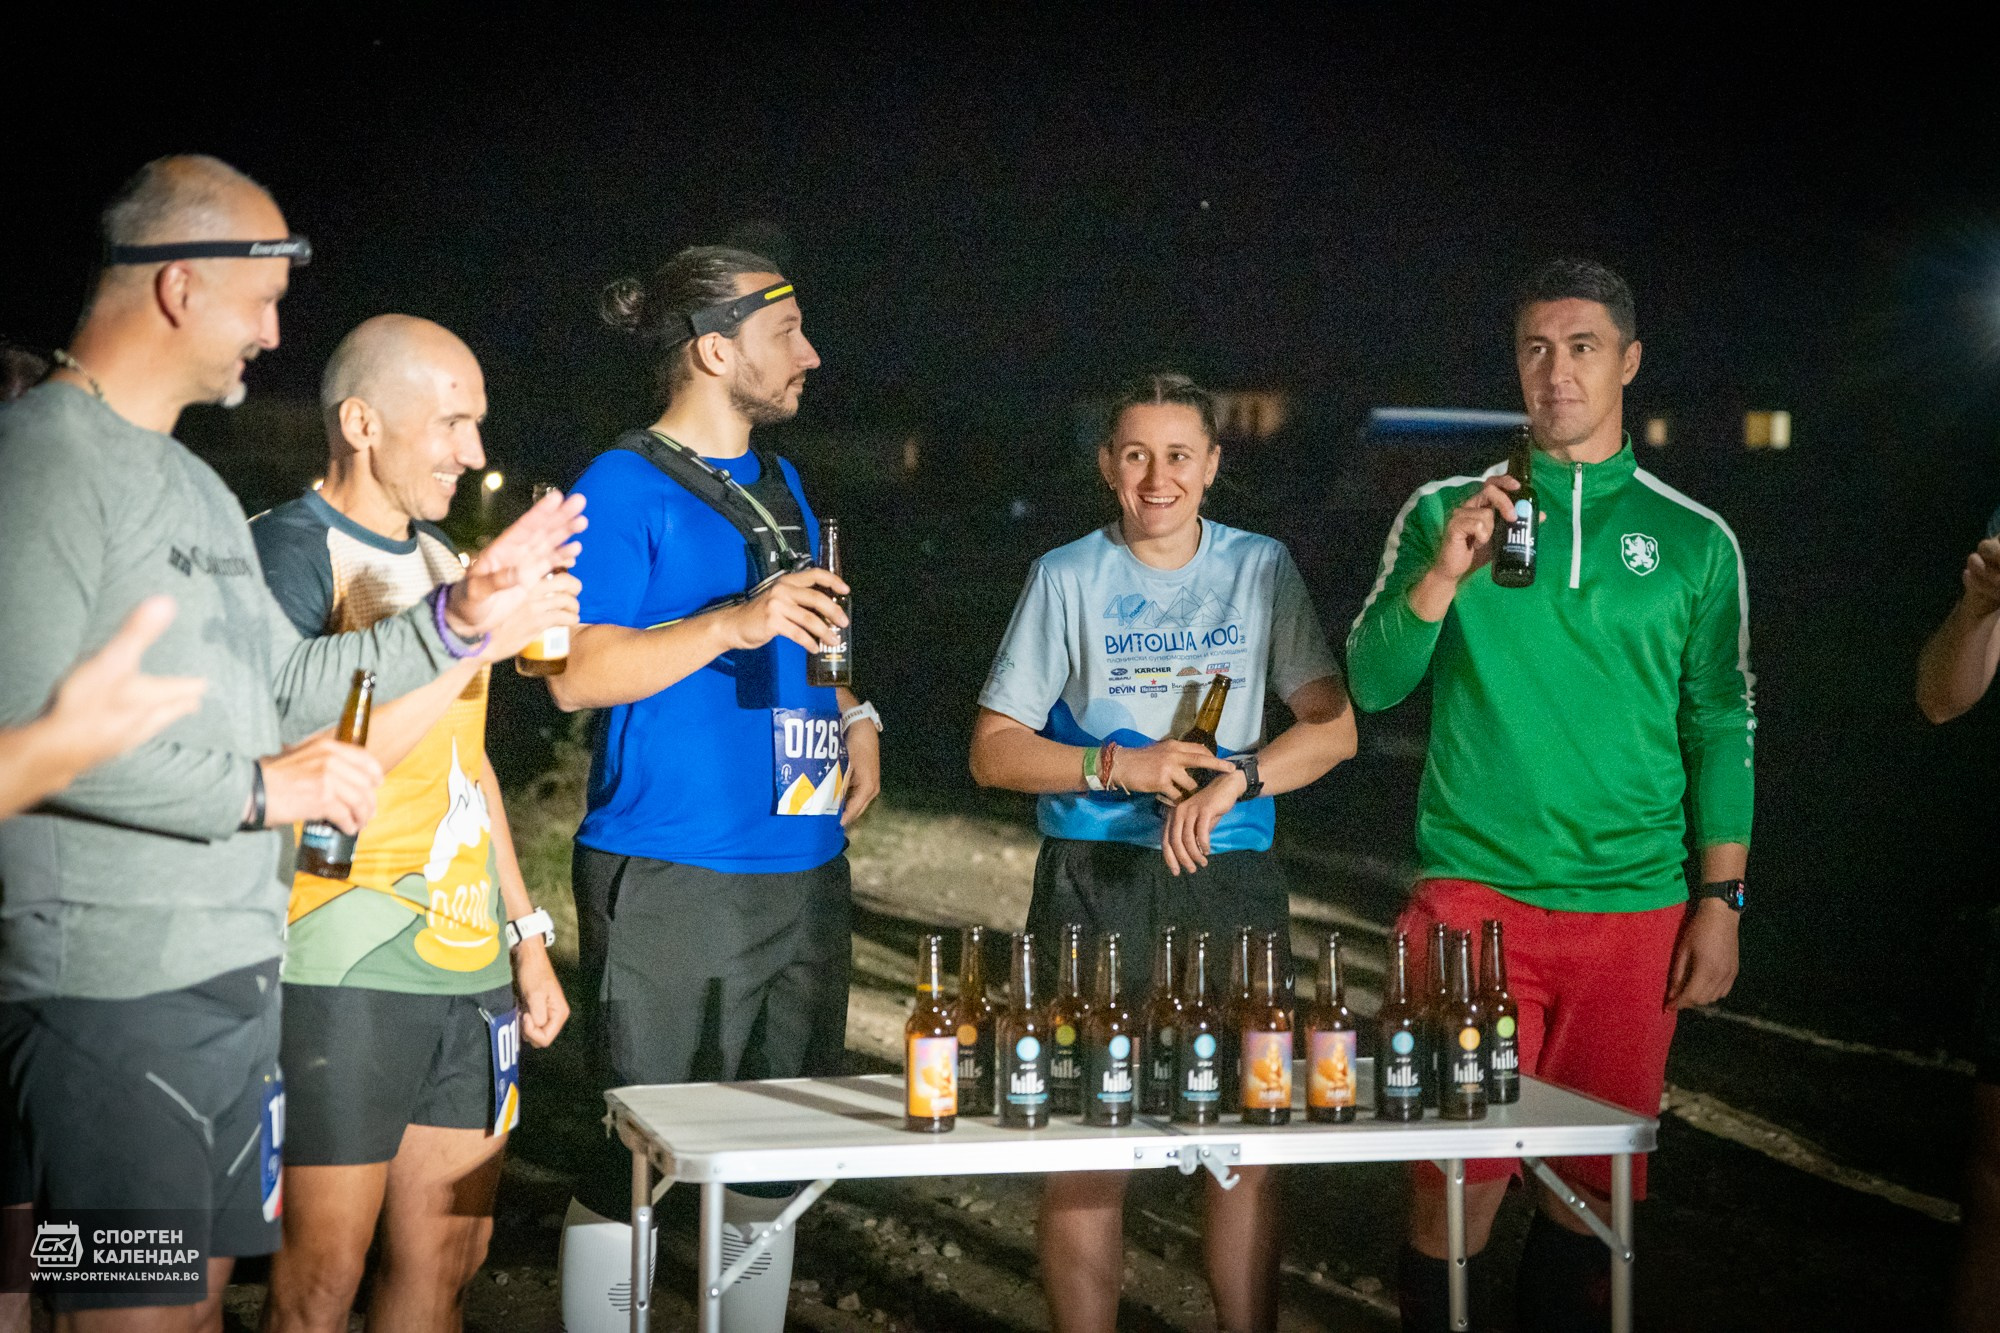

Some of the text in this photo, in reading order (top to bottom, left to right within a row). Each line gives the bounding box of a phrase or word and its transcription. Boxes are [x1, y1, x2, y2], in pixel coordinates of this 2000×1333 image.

[1104, 624, 1239, 655] ВИТОША 100
[1109, 686, 1136, 695] DEVIN
[784, 718, 839, 760] 0126
[498, 1018, 520, 1072] 01
[958, 1057, 983, 1079] ills
[1491, 1050, 1519, 1070] hills
[1011, 1072, 1045, 1094] hills
[1103, 1070, 1132, 1093] hills
[1188, 1069, 1219, 1091] hills
[1387, 1065, 1419, 1087] hills
[1454, 1062, 1485, 1083] hills
